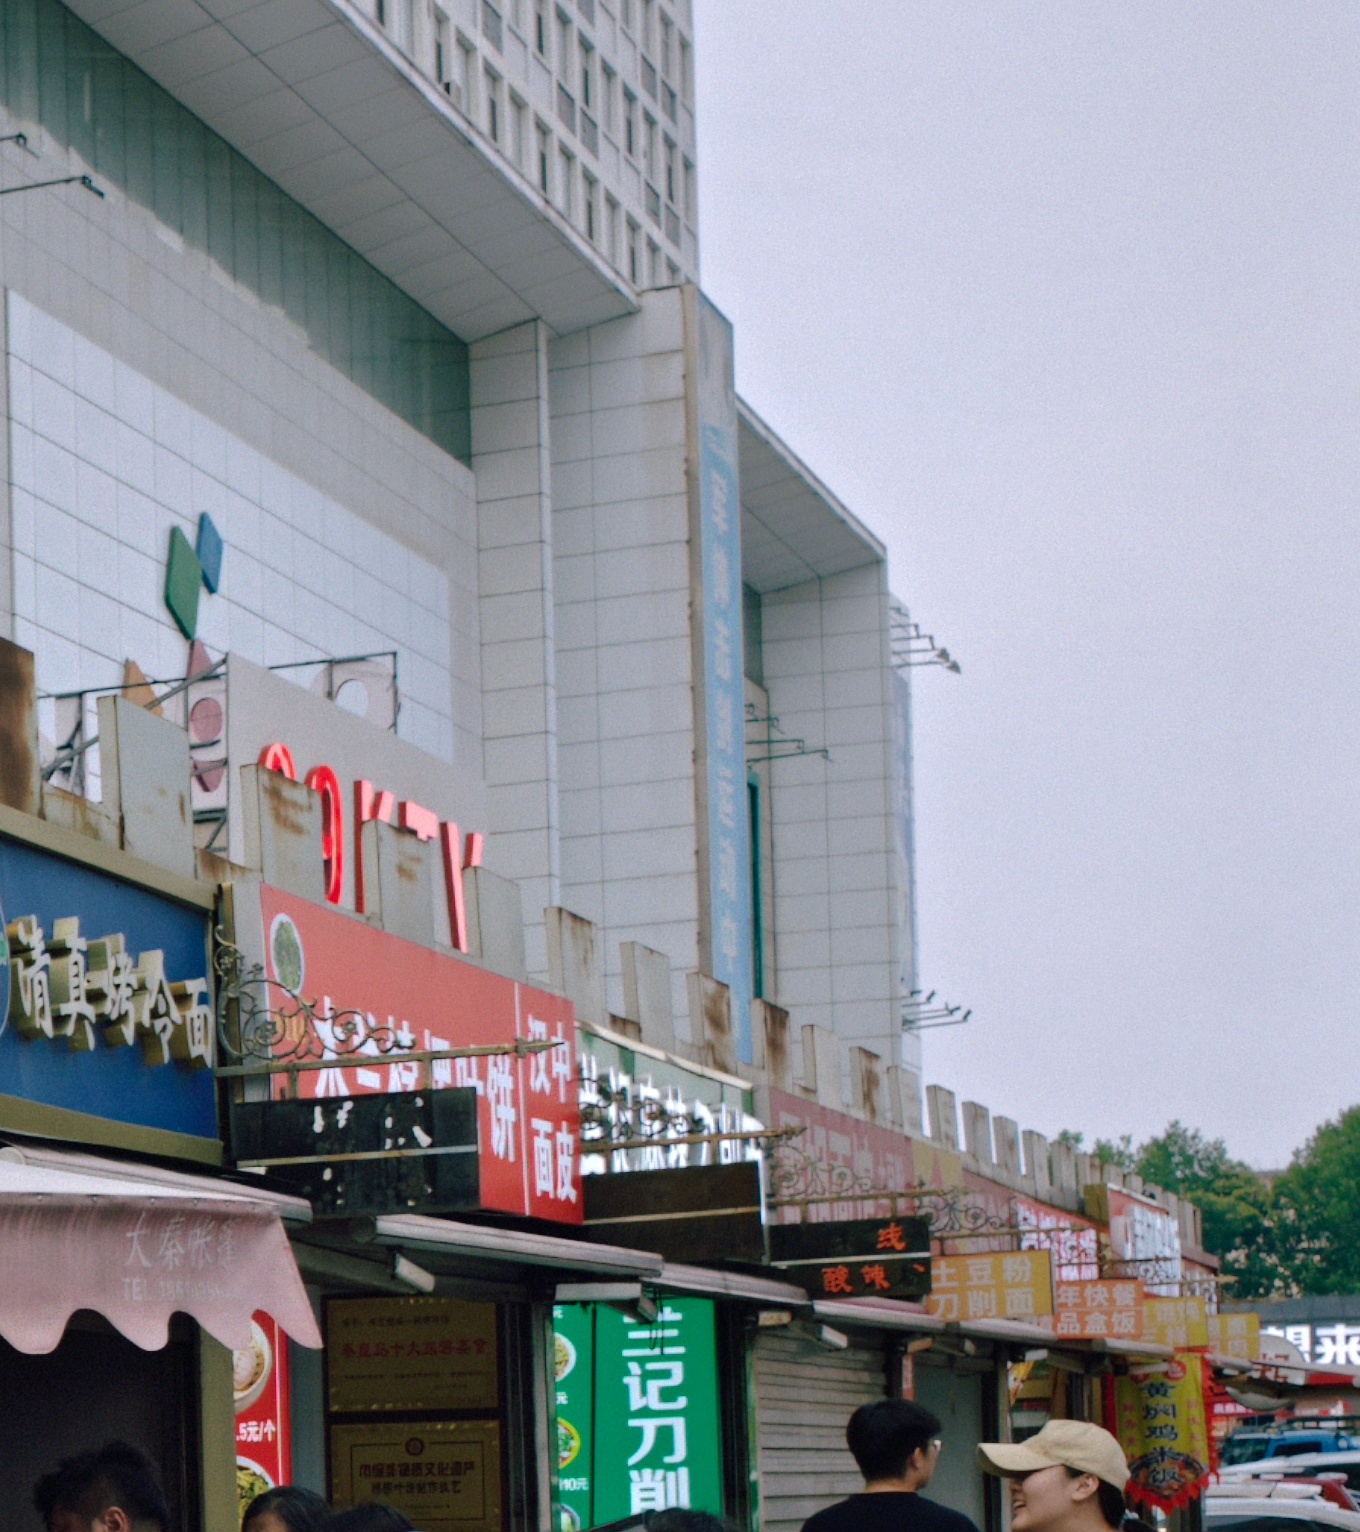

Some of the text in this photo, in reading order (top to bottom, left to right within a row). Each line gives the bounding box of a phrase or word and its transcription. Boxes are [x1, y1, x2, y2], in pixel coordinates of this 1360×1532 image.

[12, 917, 213, 1069] 清真烤冷面
[527, 1014, 571, 1104] 汉中
[531, 1118, 577, 1204] 面皮
[931, 1256, 1033, 1288] 土豆粉
[931, 1287, 1035, 1320] 刀削面
